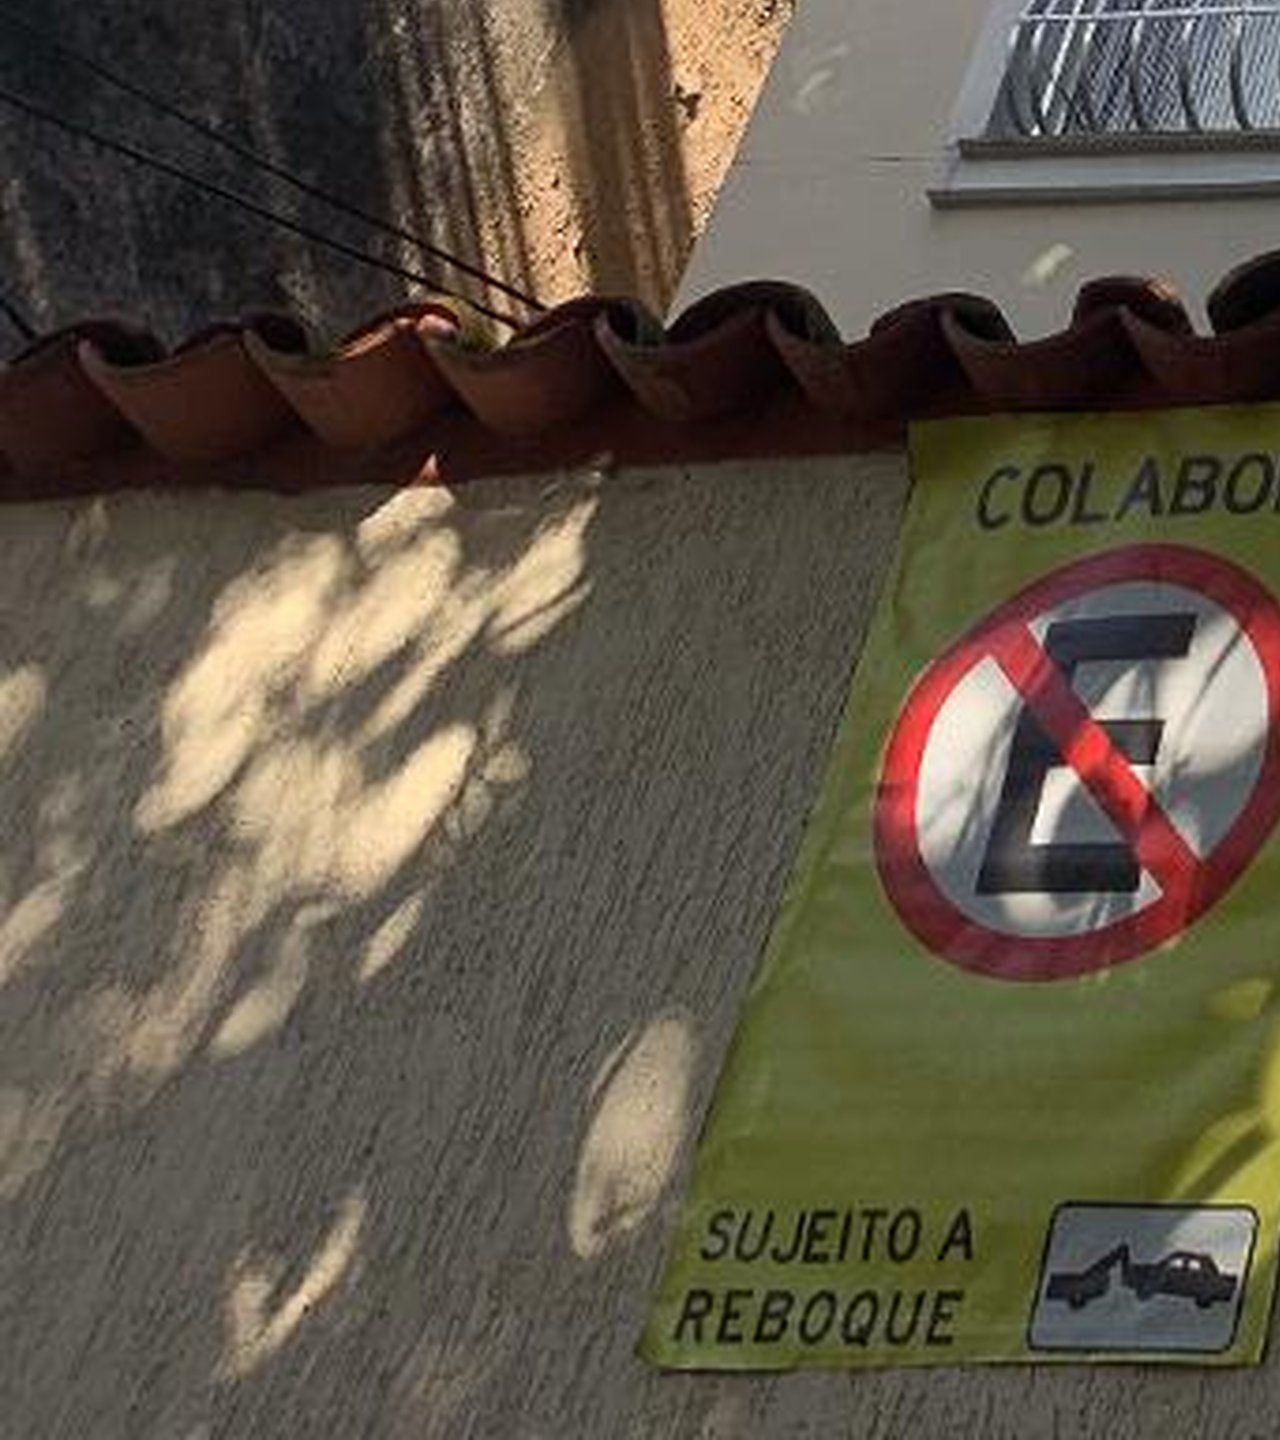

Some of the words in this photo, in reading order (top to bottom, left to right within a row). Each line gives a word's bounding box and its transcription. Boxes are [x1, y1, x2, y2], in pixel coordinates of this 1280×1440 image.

[699, 1208, 923, 1262] SUJEITO
[936, 1209, 975, 1262] A
[672, 1288, 965, 1347] REBOQUE
